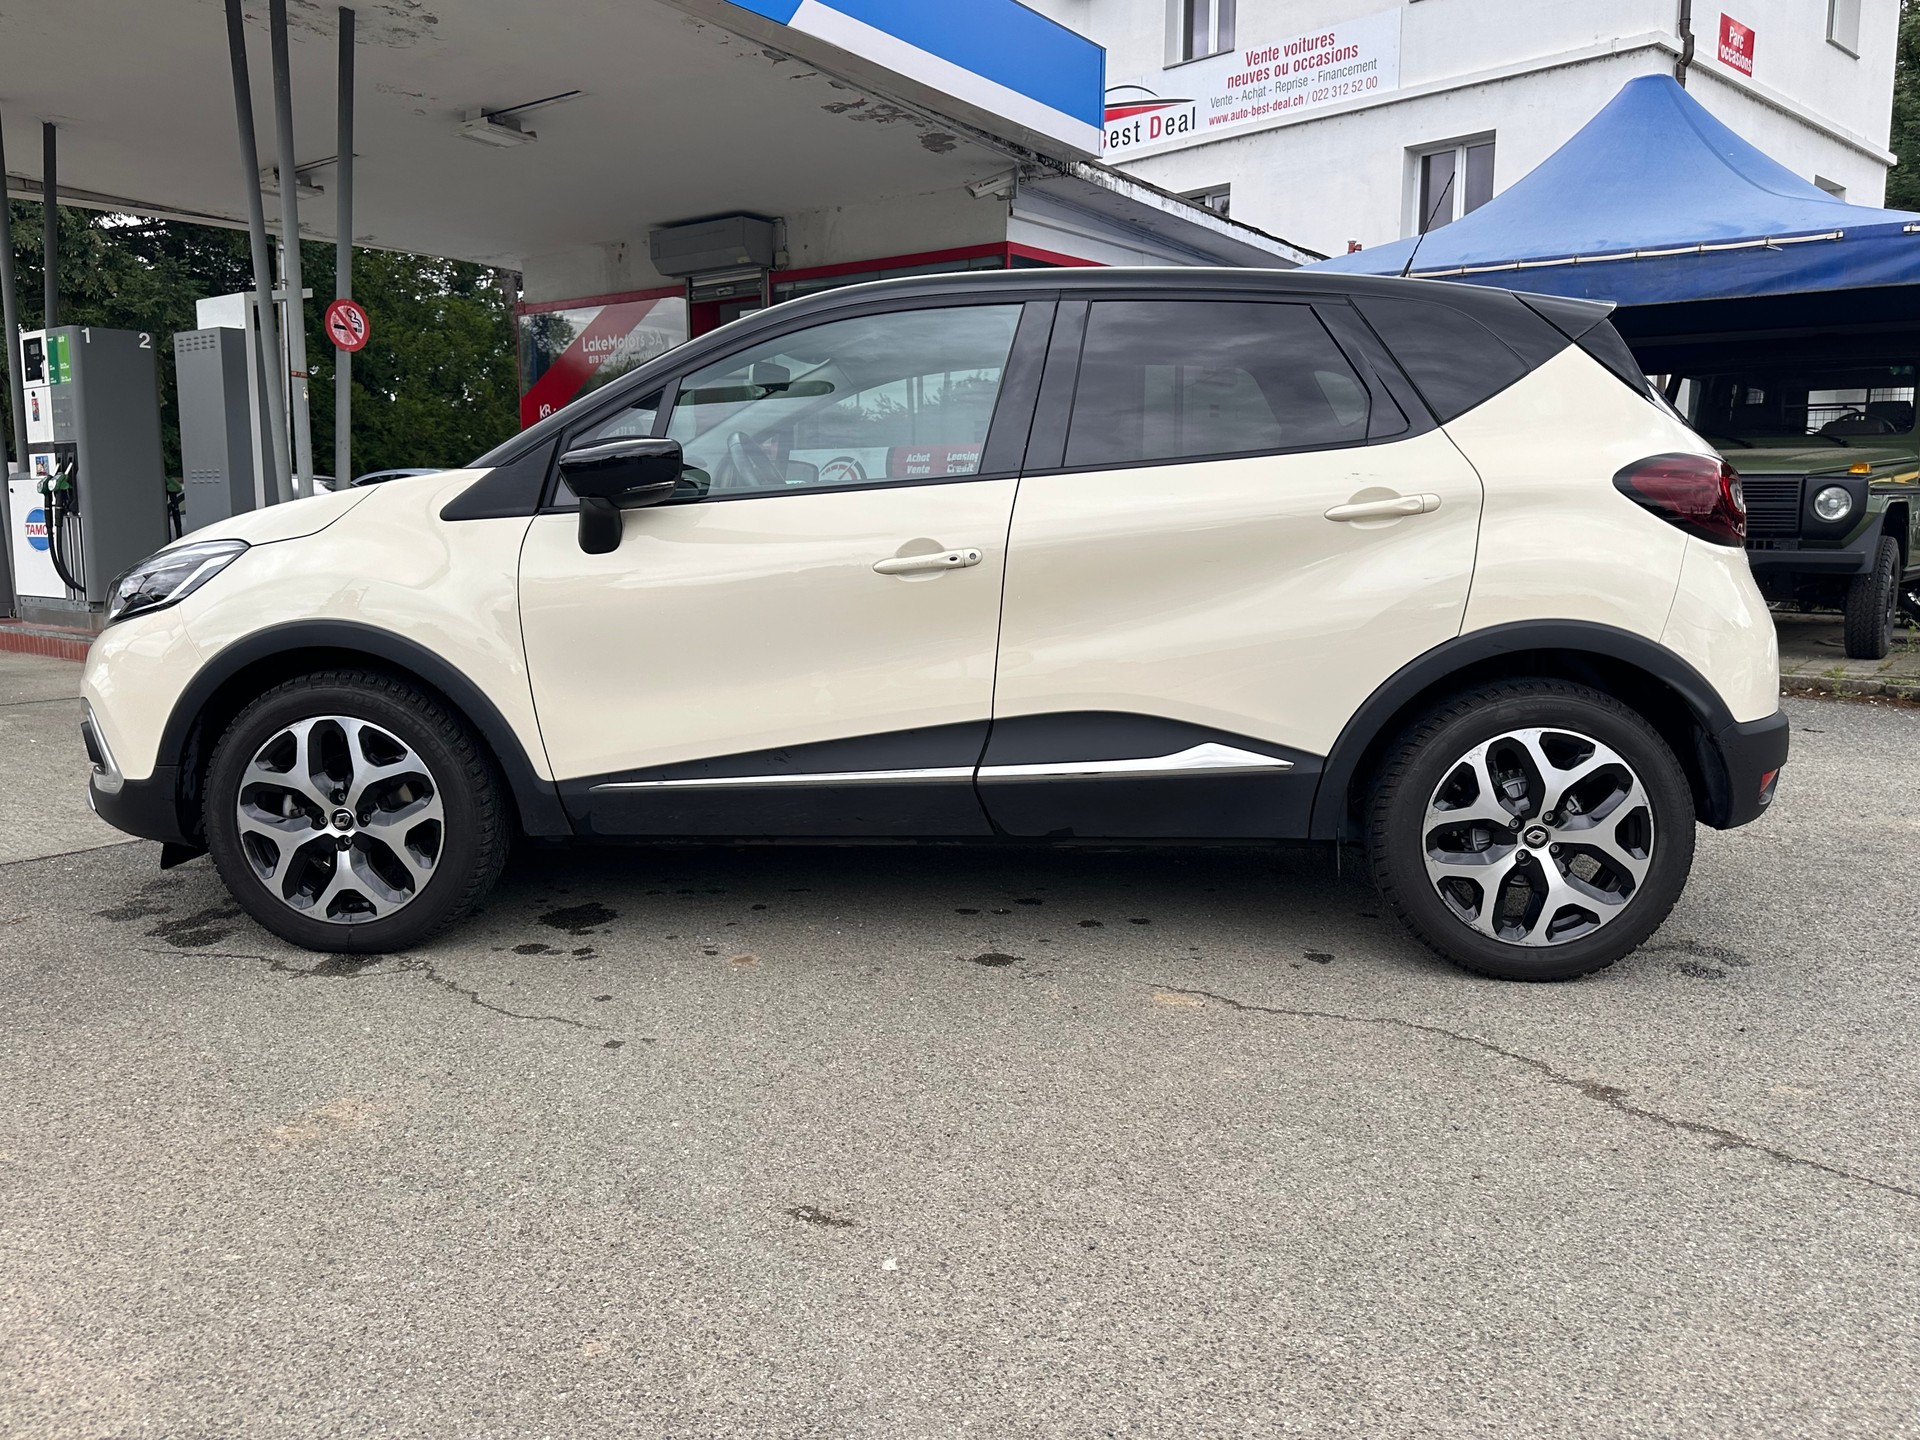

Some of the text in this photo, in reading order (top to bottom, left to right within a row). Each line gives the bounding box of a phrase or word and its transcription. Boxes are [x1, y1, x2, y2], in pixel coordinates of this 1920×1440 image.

[1245, 32, 1335, 67] Vente voitures
[1729, 26, 1744, 49] Parc
[1227, 44, 1359, 89] neuves ou occasions
[1720, 44, 1752, 73] occasions
[1210, 93, 1233, 109] Vente
[1241, 86, 1266, 102] Achat
[1275, 76, 1308, 94] Reprise
[1318, 58, 1378, 83] Financement
[1209, 94, 1304, 126] www.auto-best-deal.ch
[1312, 90, 1328, 103] 022
[1331, 83, 1349, 98] 312
[1351, 79, 1363, 93] 52
[1365, 75, 1378, 89] 00
[1104, 106, 1195, 149] est Deal
[81, 327, 91, 343] 1
[138, 332, 151, 349] 2
[582, 333, 645, 353] LakeMotors
[906, 452, 930, 463] Achat
[906, 464, 930, 474] Vente
